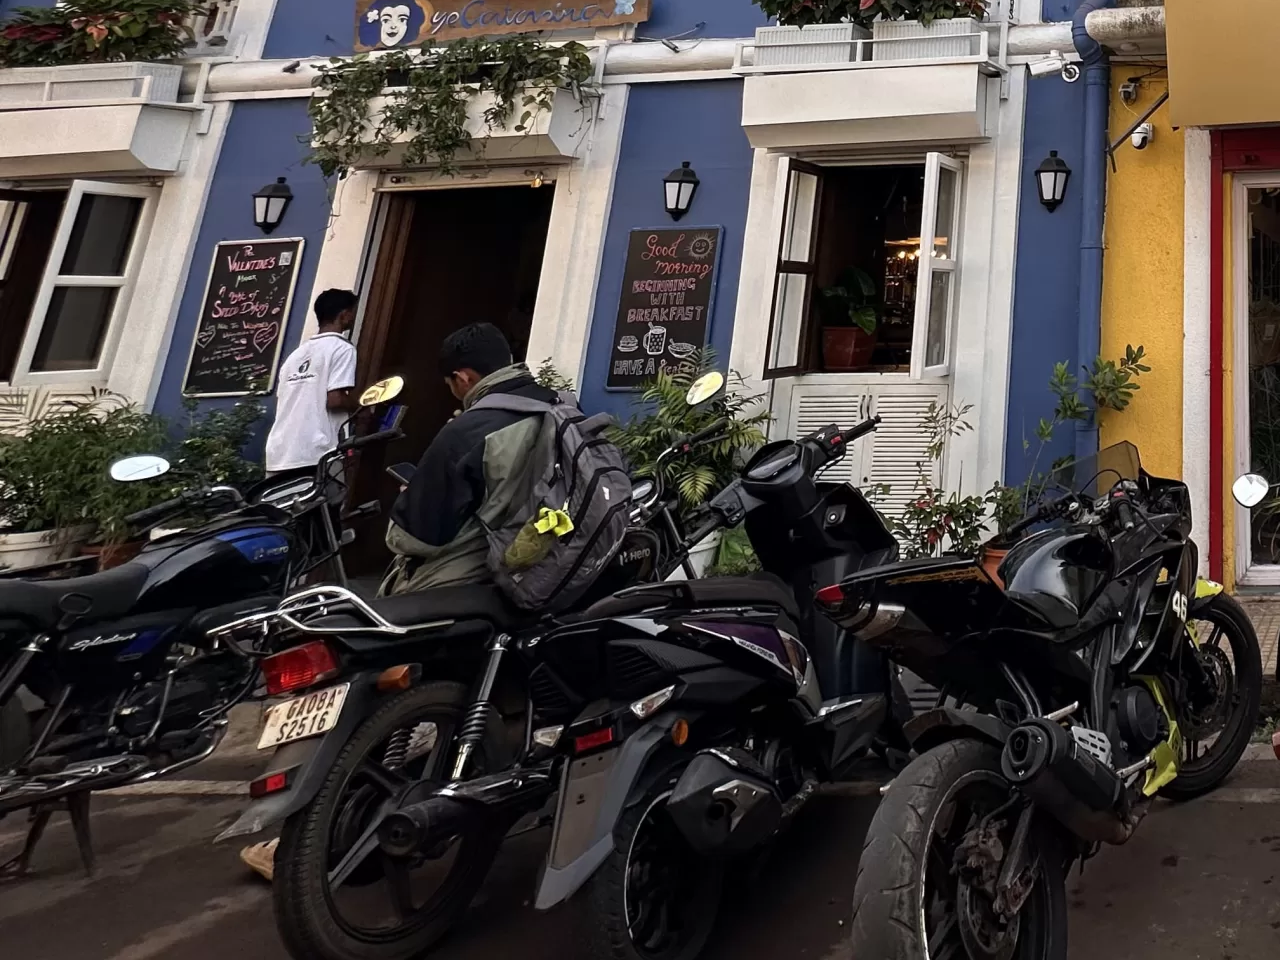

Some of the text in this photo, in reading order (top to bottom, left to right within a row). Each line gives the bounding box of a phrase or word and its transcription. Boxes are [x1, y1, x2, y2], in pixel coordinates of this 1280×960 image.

[641, 233, 686, 260] Good
[632, 277, 697, 293] BEGINNING
[650, 292, 685, 305] WITH
[627, 306, 704, 323] BREAKFAST
[613, 359, 644, 376] HAVE
[645, 358, 656, 374] A
[1172, 590, 1188, 623] 46
[286, 689, 337, 721] GA08A
[276, 711, 329, 742] S2516
